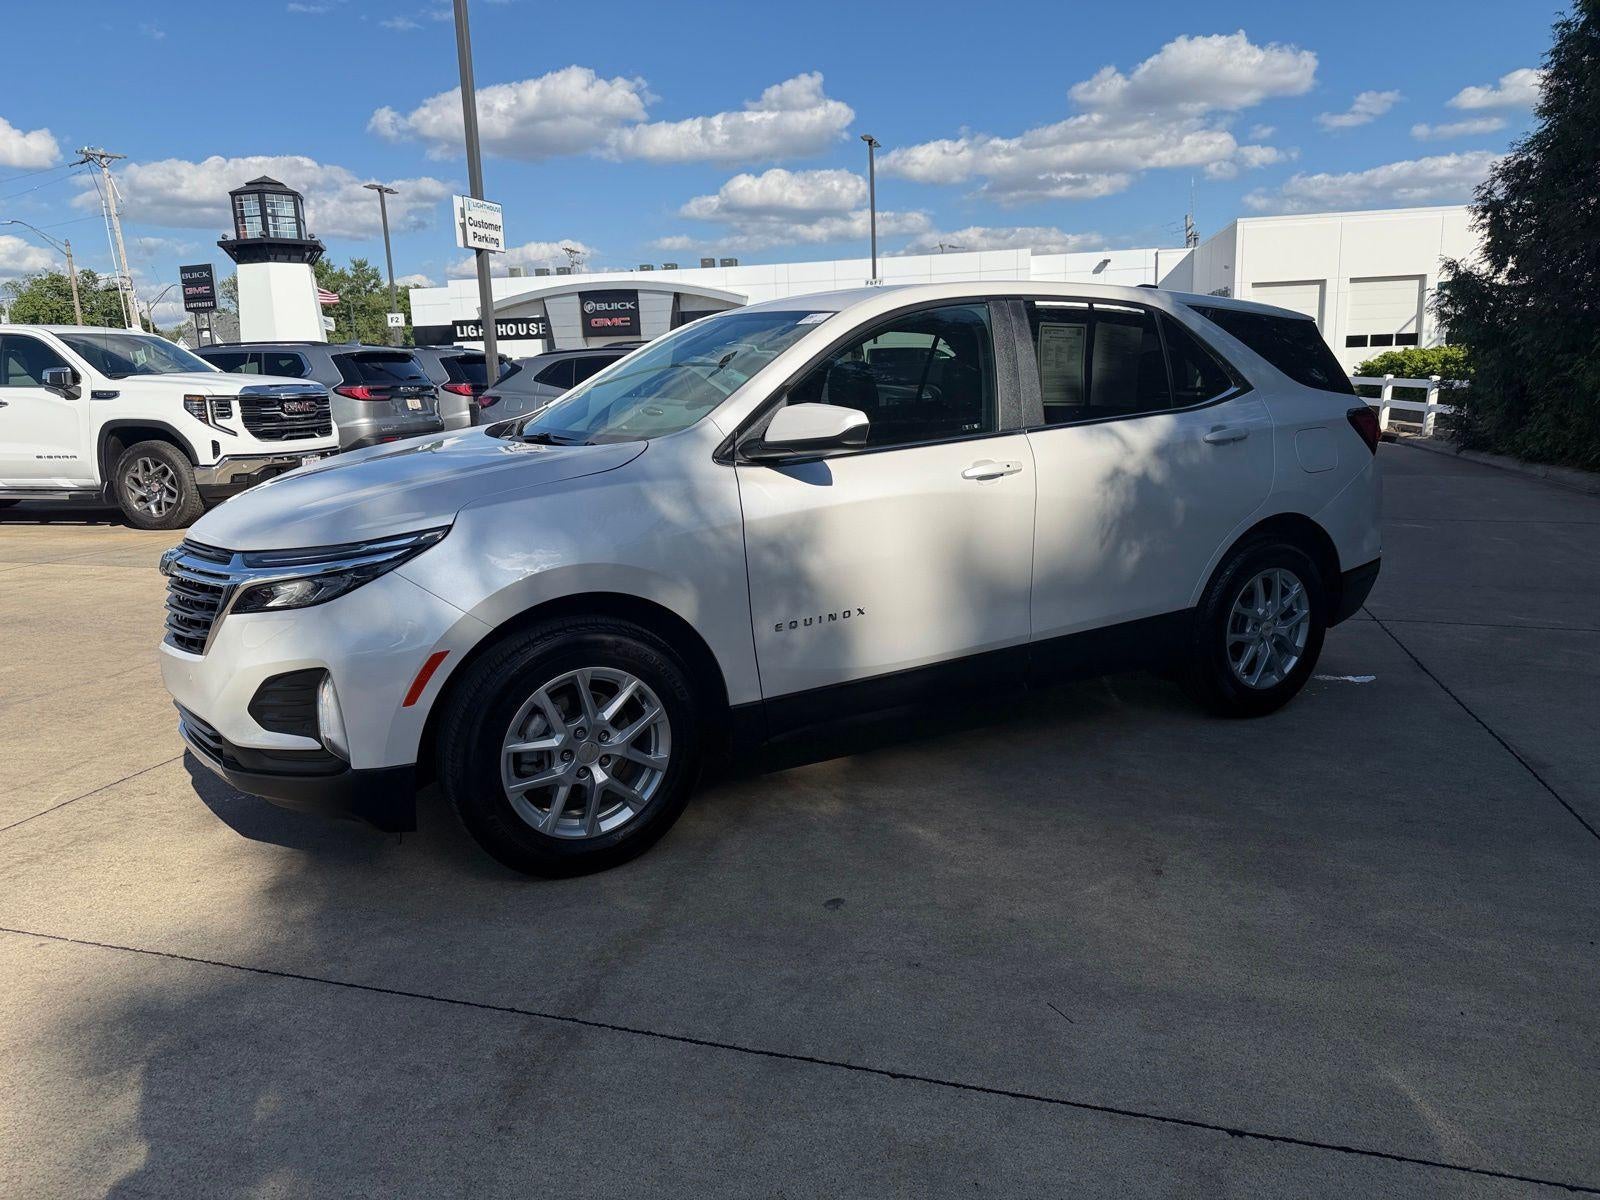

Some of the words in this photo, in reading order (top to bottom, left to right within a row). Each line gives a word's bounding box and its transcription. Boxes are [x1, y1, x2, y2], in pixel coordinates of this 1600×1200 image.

[468, 217, 501, 232] Customer
[473, 232, 499, 247] Parking
[182, 271, 210, 280] BUICK
[185, 286, 210, 294] GMC
[596, 302, 636, 310] BUICK
[591, 317, 630, 327] GMC
[456, 323, 546, 338] LIGHOUSE
[283, 401, 317, 412] GMC
[775, 607, 866, 632] EQUINOX
